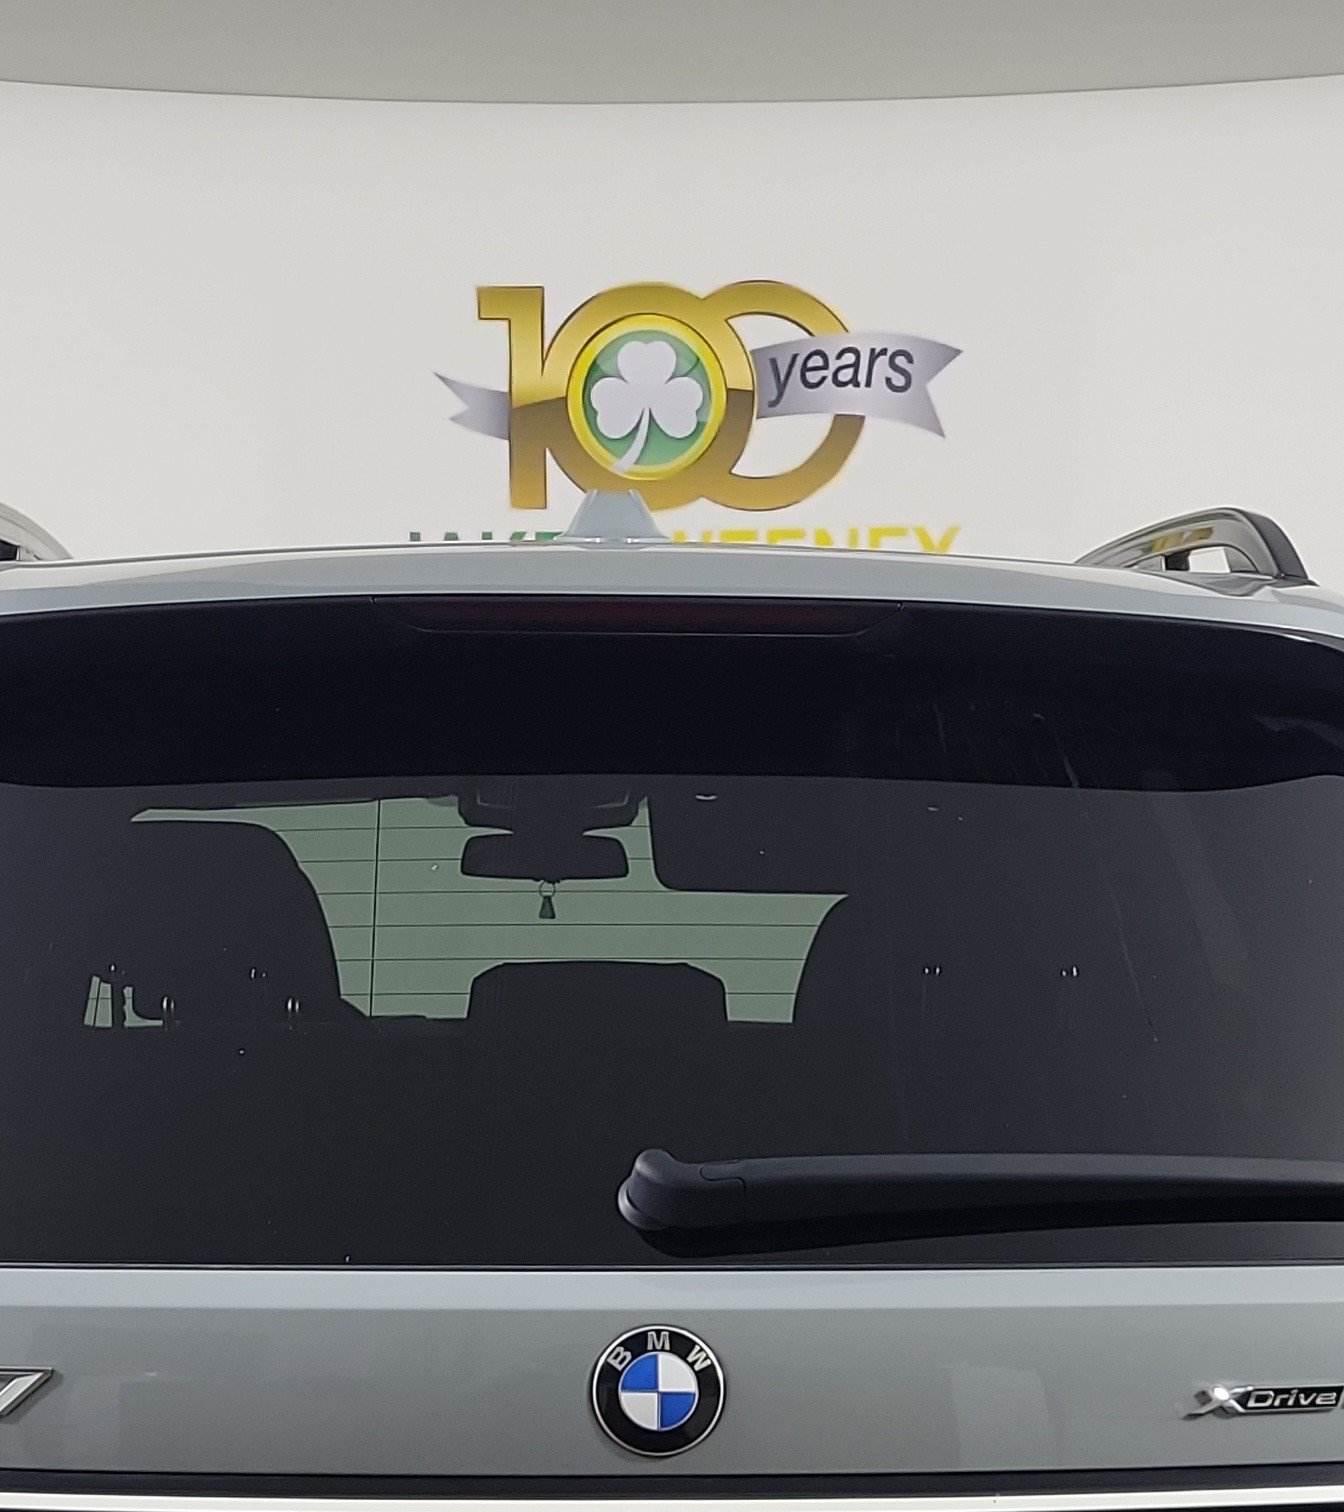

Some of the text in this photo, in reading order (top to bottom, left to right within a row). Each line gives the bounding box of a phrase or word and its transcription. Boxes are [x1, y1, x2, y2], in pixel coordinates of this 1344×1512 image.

[475, 280, 915, 511] 100 years
[607, 1331, 711, 1372] BMW
